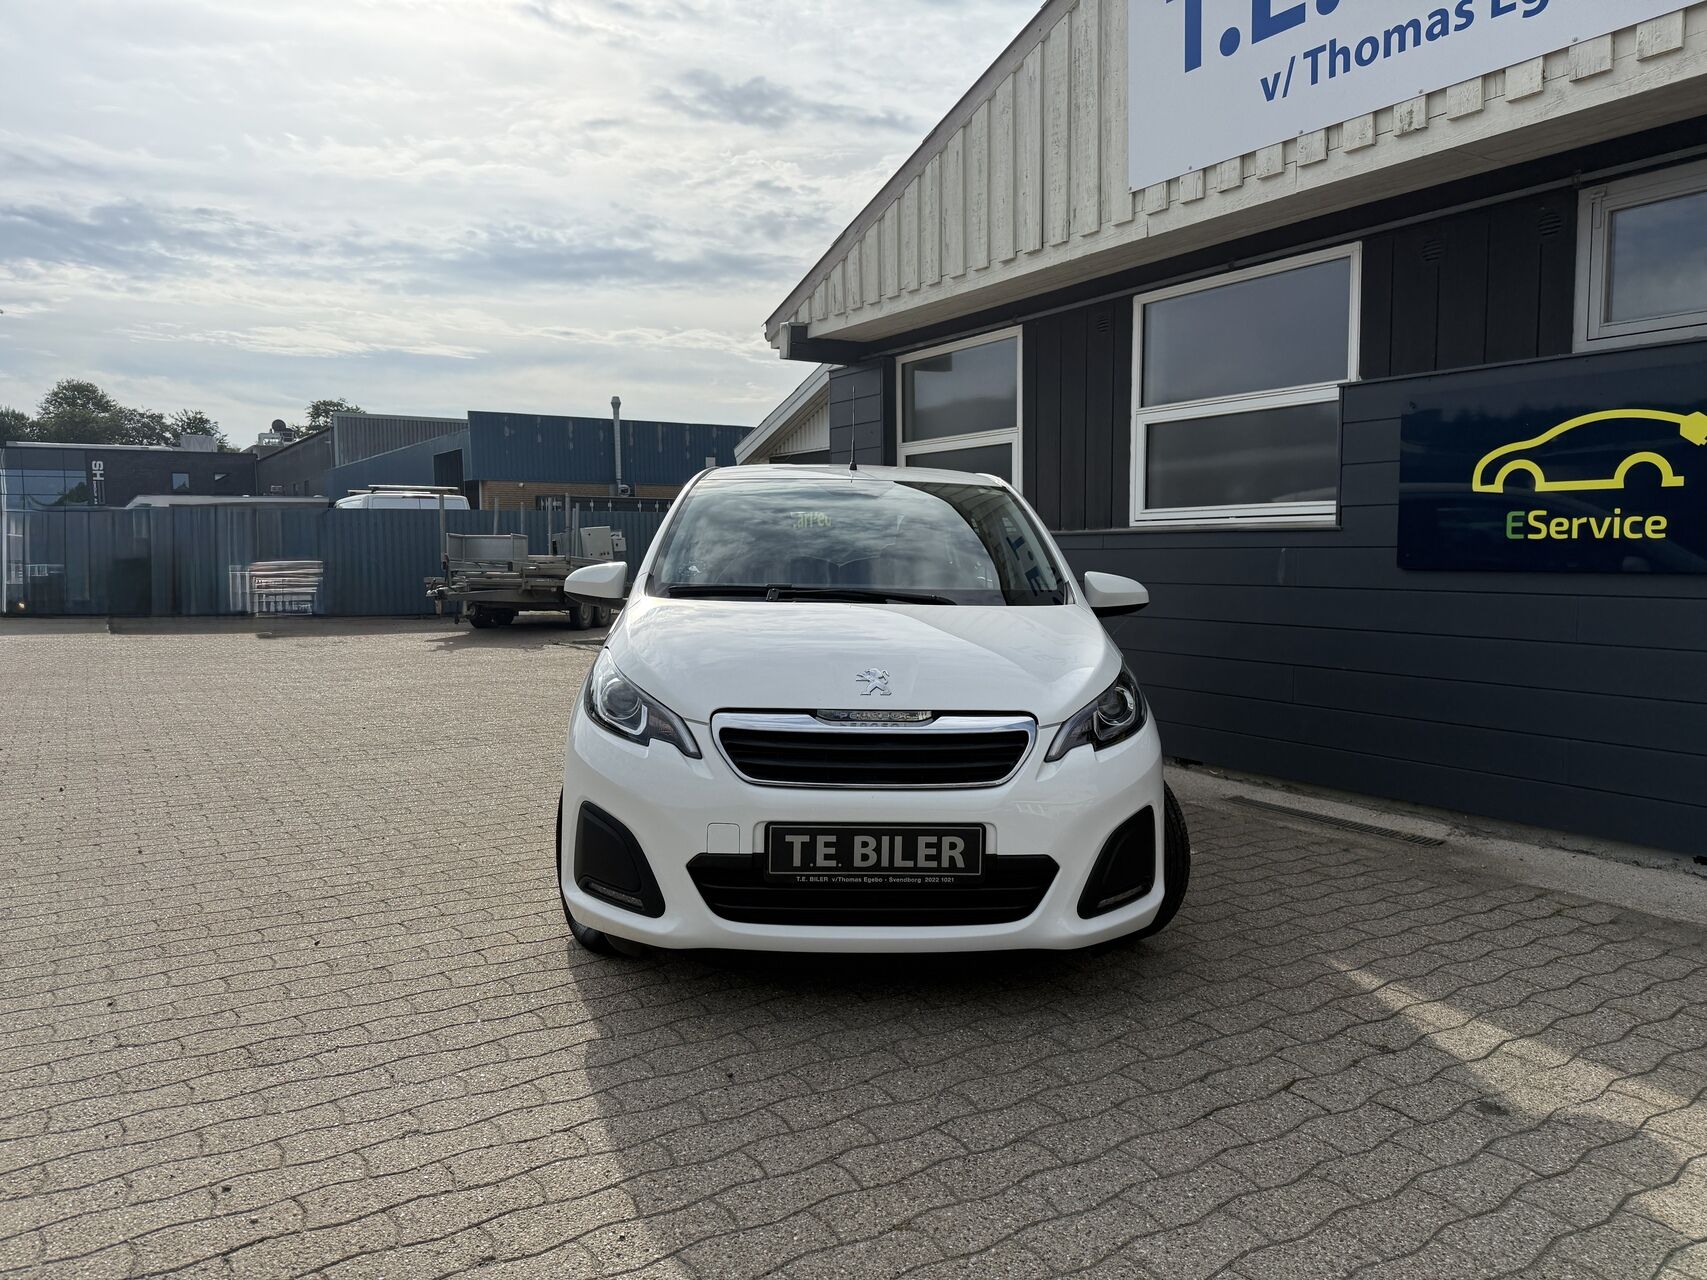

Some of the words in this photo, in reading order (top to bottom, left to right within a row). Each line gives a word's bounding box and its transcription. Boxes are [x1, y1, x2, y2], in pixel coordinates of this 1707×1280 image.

[1506, 508, 1667, 539] EService
[785, 834, 842, 867] T.E.
[853, 835, 965, 868] BILER
[888, 876, 922, 885] Svendborg
